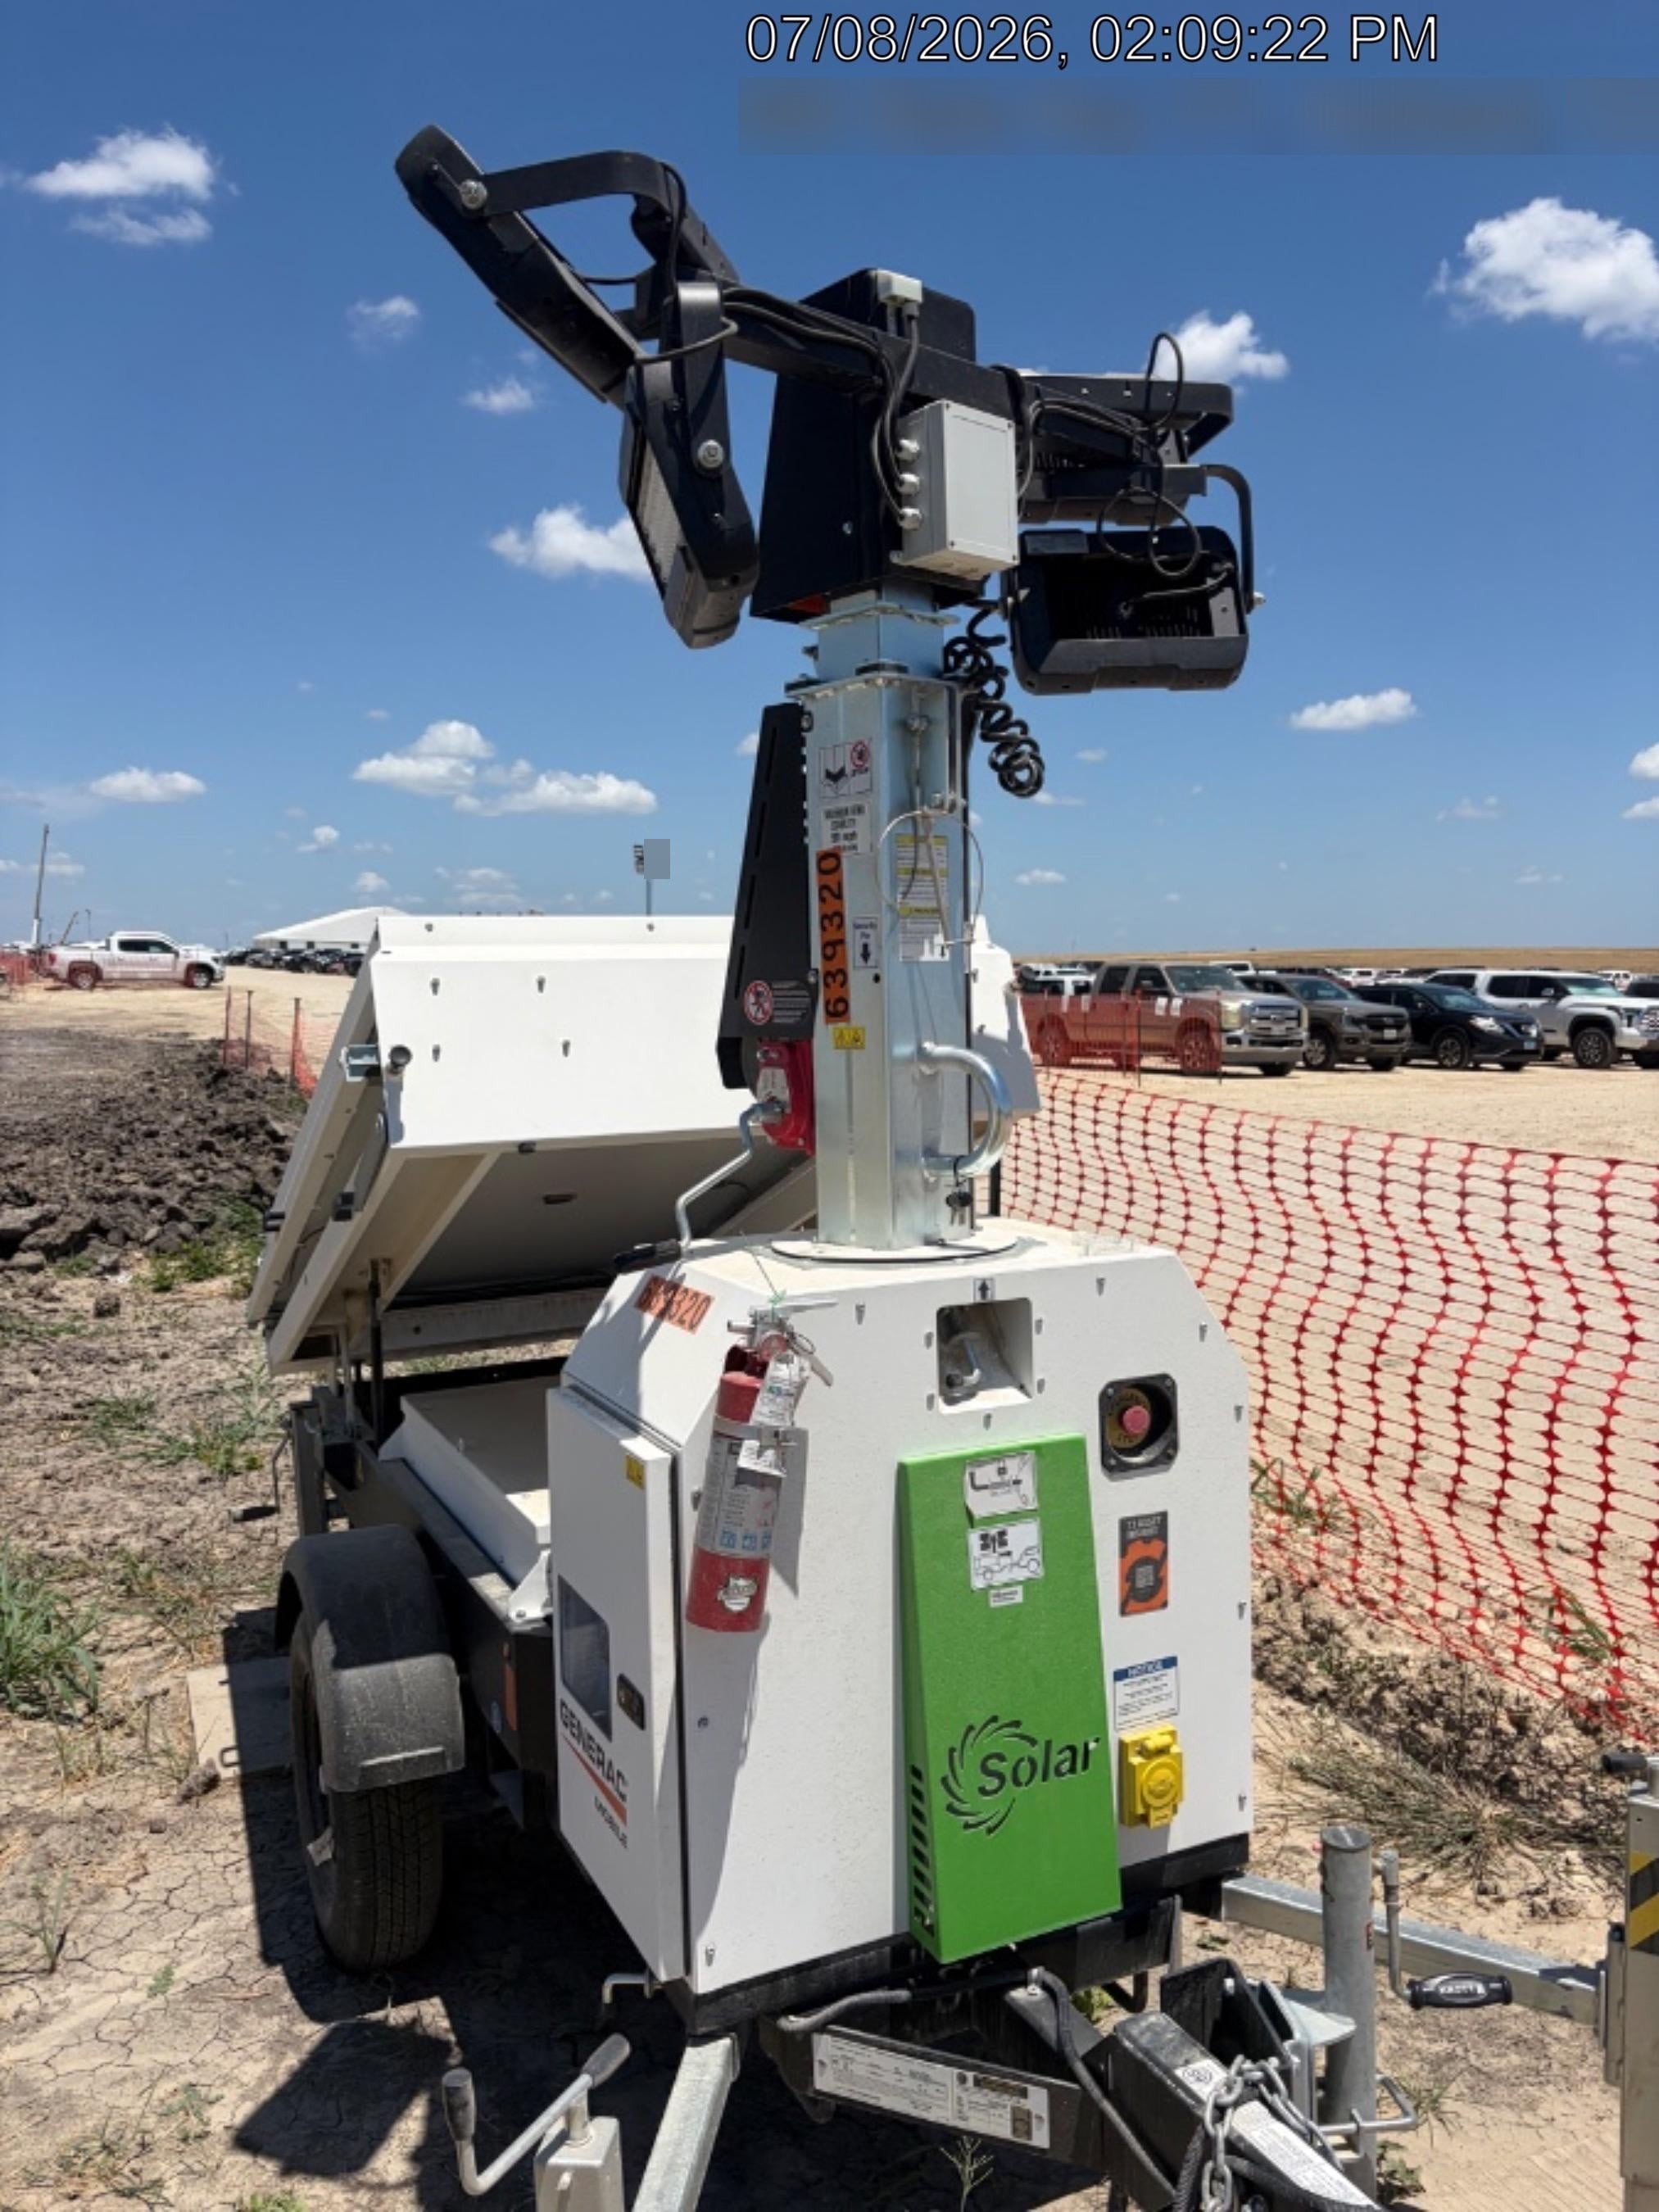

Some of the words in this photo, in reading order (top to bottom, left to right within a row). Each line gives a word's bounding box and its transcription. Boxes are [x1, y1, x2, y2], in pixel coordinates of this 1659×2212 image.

[817, 850, 850, 1018] 639320
[560, 1697, 629, 1803] GENERAC
[977, 1736, 1101, 1797] Solar
